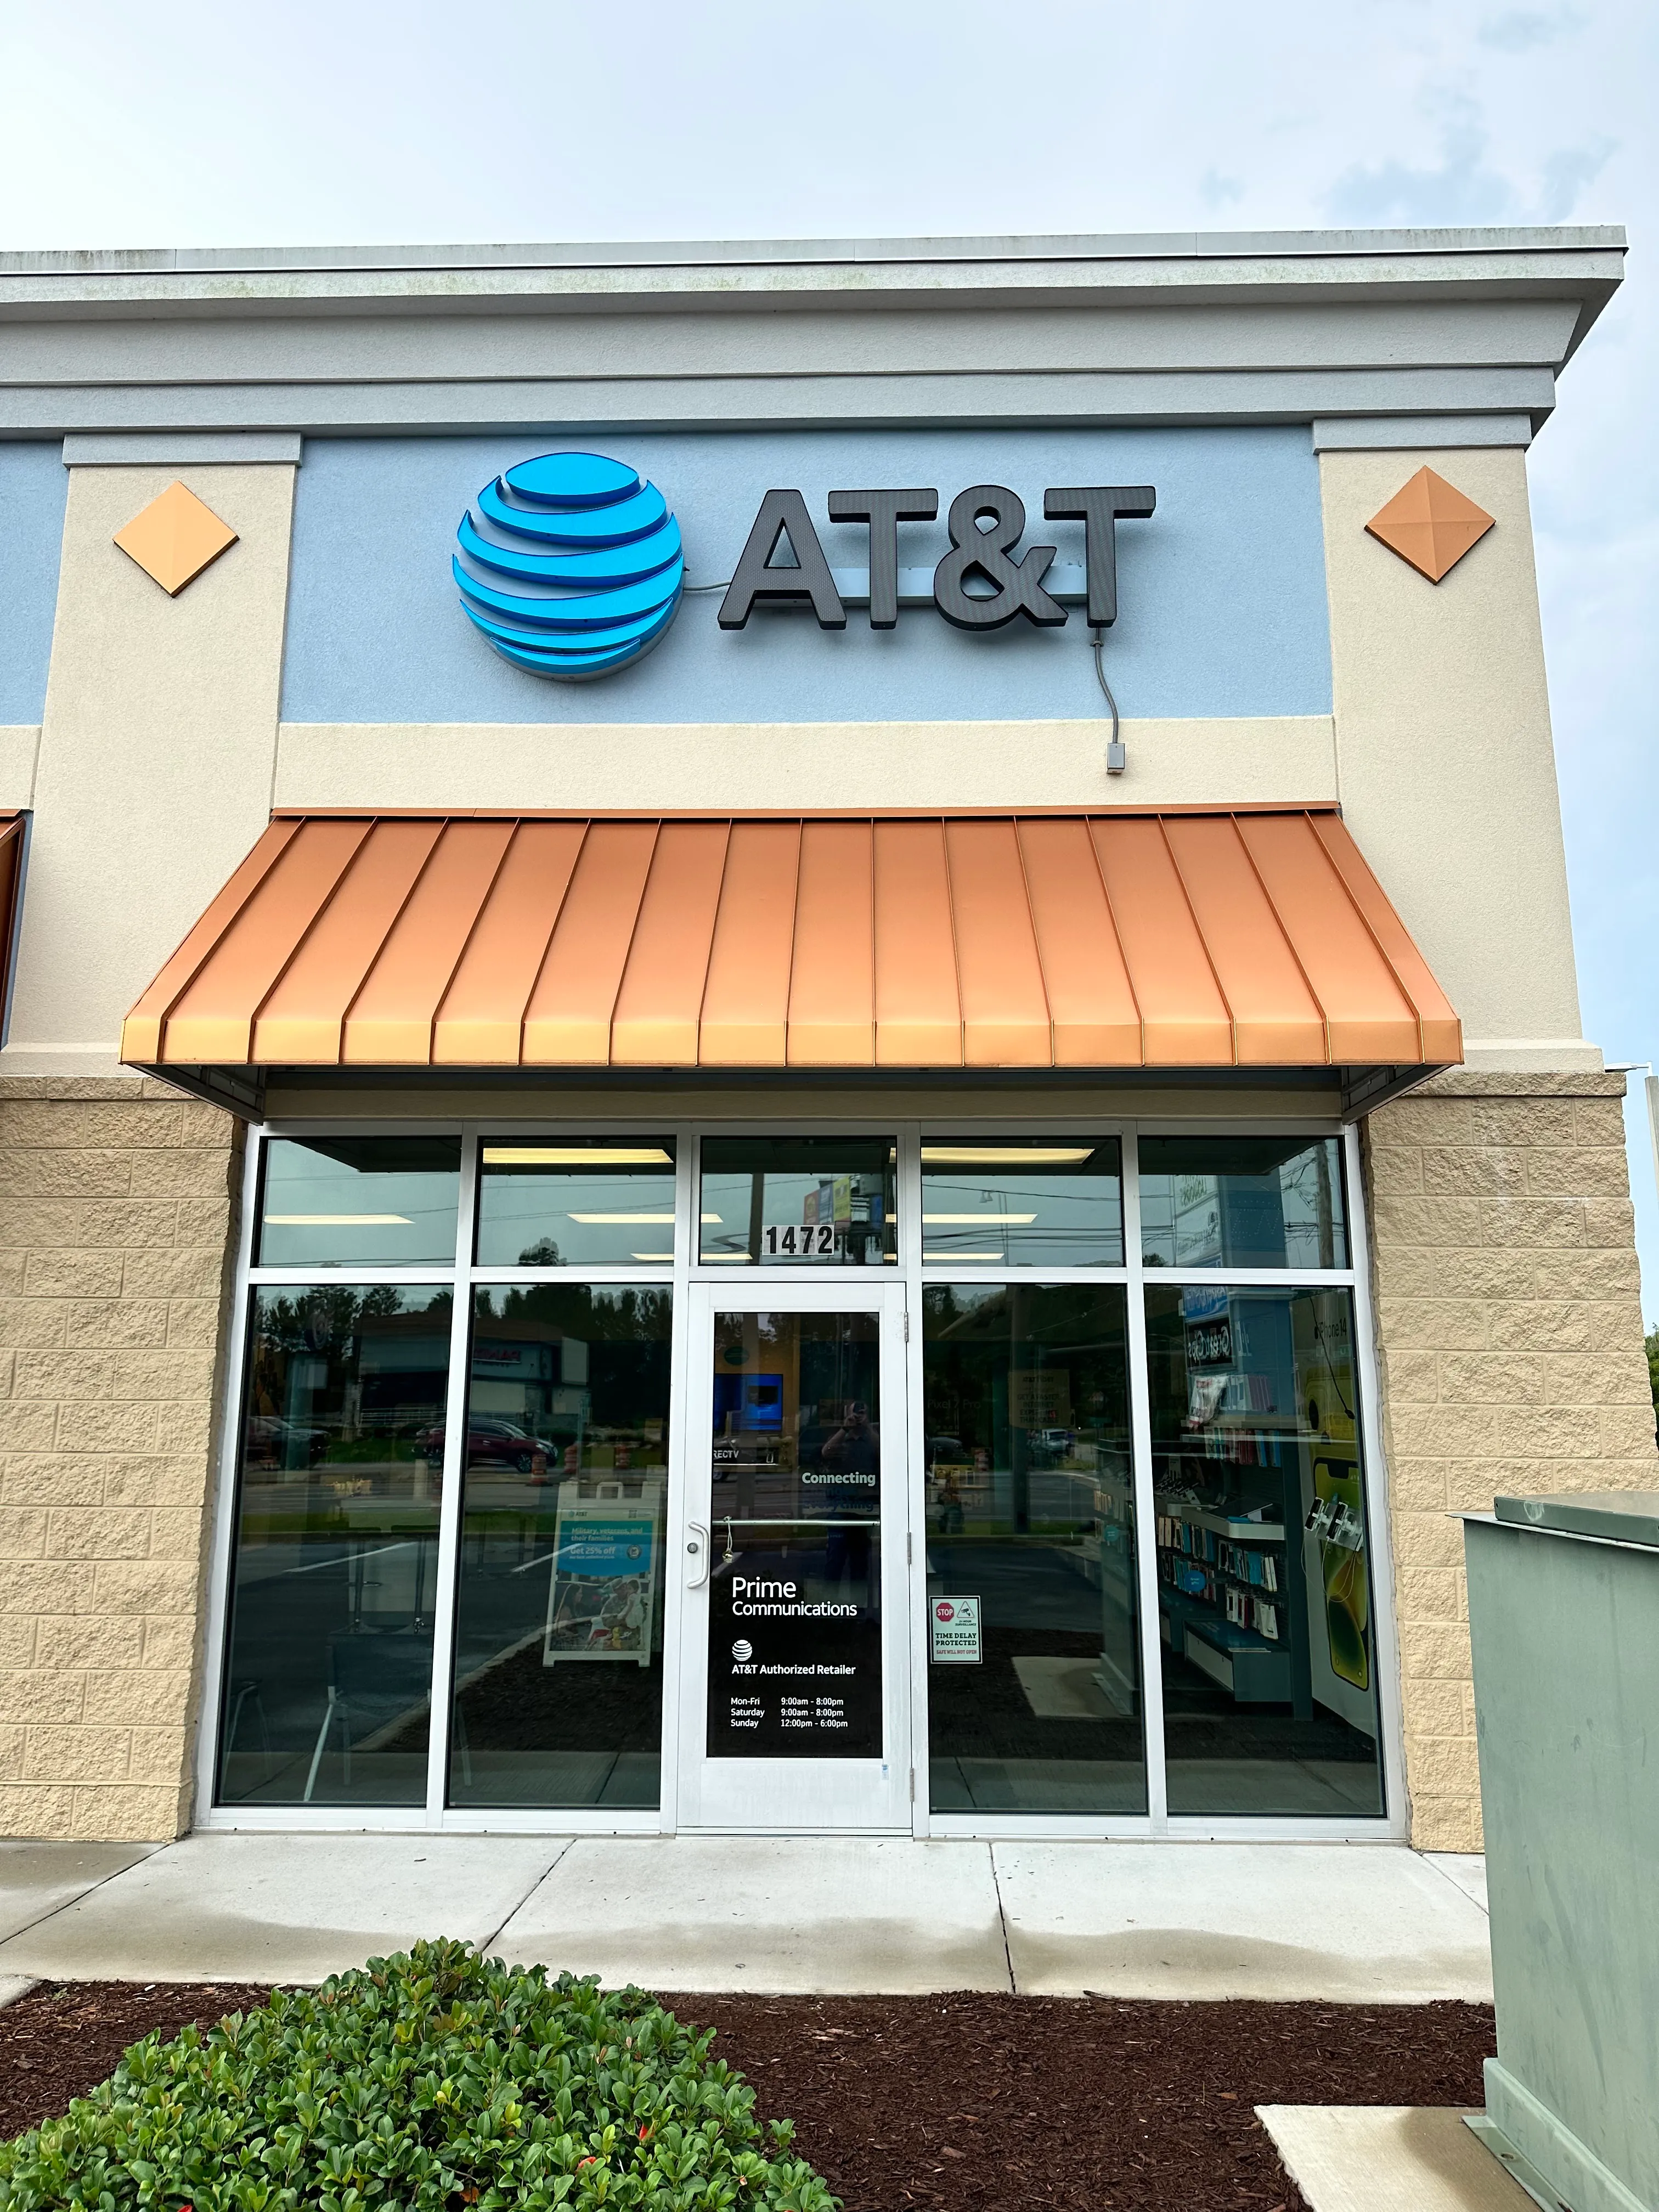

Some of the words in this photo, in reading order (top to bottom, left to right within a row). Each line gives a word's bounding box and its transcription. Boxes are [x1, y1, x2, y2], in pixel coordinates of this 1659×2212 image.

[718, 485, 1155, 630] AT&T
[766, 1226, 832, 1254] 1472
[927, 1398, 951, 1409] Pixel
[963, 1398, 981, 1409] Pro
[802, 1471, 876, 1486] Connecting
[732, 1577, 796, 1598] Prime
[732, 1601, 857, 1616] Communications
[731, 1665, 758, 1674] AT&T
[759, 1664, 815, 1674] Authorized
[817, 1664, 856, 1674] Retailer
[816, 1697, 844, 1707] 8:00pm
[731, 1708, 765, 1717] Saturday
[816, 1709, 844, 1718] 8:00pm
[731, 1719, 759, 1728] Sunday
[781, 1719, 812, 1729] 12:00pm
[820, 1719, 848, 1729] 6:00pm
